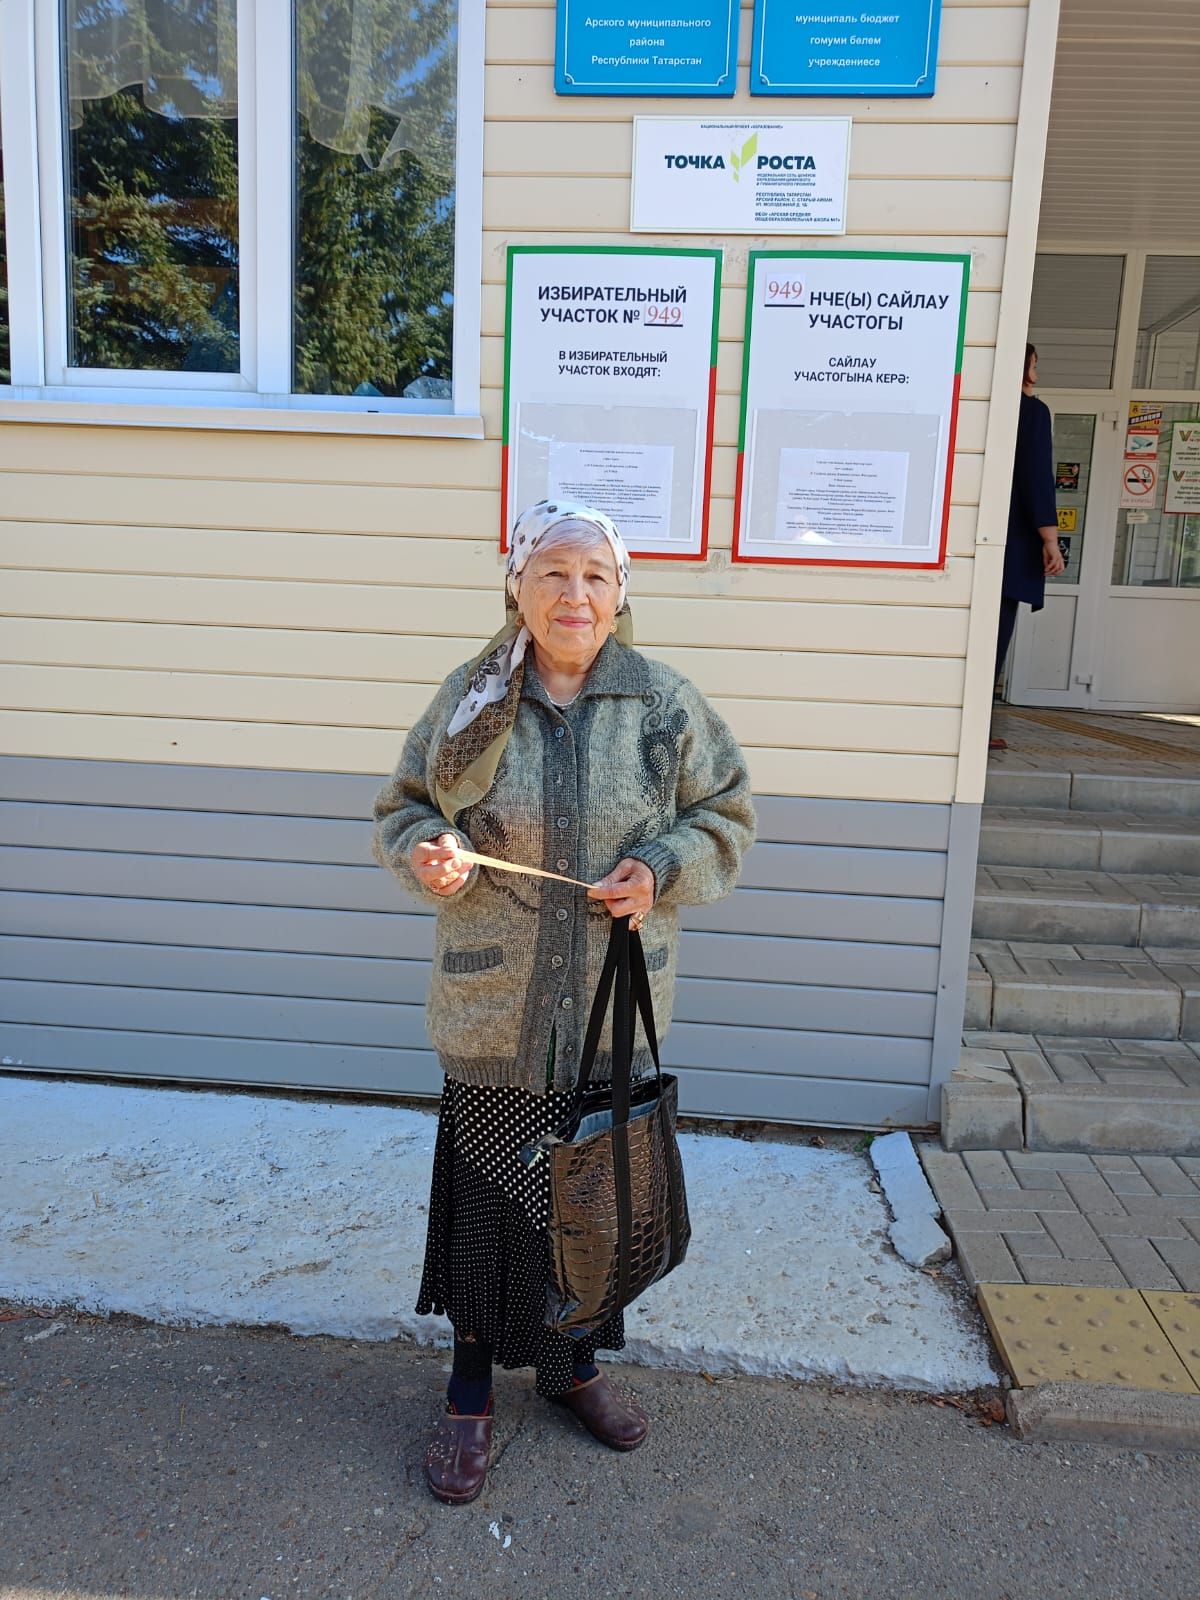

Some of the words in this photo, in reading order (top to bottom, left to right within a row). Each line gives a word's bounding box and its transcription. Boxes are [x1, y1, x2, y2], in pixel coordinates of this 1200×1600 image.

[585, 17, 624, 28] Арского
[627, 18, 711, 28] муниципального
[795, 14, 857, 24] муниципаль
[860, 13, 899, 24] бюджет
[629, 37, 665, 48] района
[810, 37, 847, 47] гомуми
[849, 35, 881, 45] белем
[591, 55, 649, 67] Республики
[652, 56, 702, 67] Татарстан
[808, 58, 880, 68] учреждениесе
[664, 155, 726, 170] ТОЧКА
[757, 155, 816, 170] РОСТА
[538, 286, 687, 303] ИЗБИРАТЕЛЬНЫЙ
[768, 280, 803, 299] 949
[809, 291, 872, 310] НЧЕ(Ы)
[877, 291, 949, 310] САЙЛАУ
[540, 308, 618, 324] УЧАСТОК
[623, 309, 640, 324] №
[647, 305, 681, 325] 949
[809, 314, 903, 330] УЧАСТОГЫ
[559, 351, 566, 360] В
[569, 350, 668, 363] ИЗБИРАТЕЛЬНЫЙ
[828, 355, 877, 369] САЙЛАУ
[558, 365, 610, 376] УЧАСТОК
[613, 366, 661, 378] ВХОДЯТ:
[794, 371, 873, 383] УЧАСТОГЫНА
[876, 373, 910, 384] КЕРӘ:
